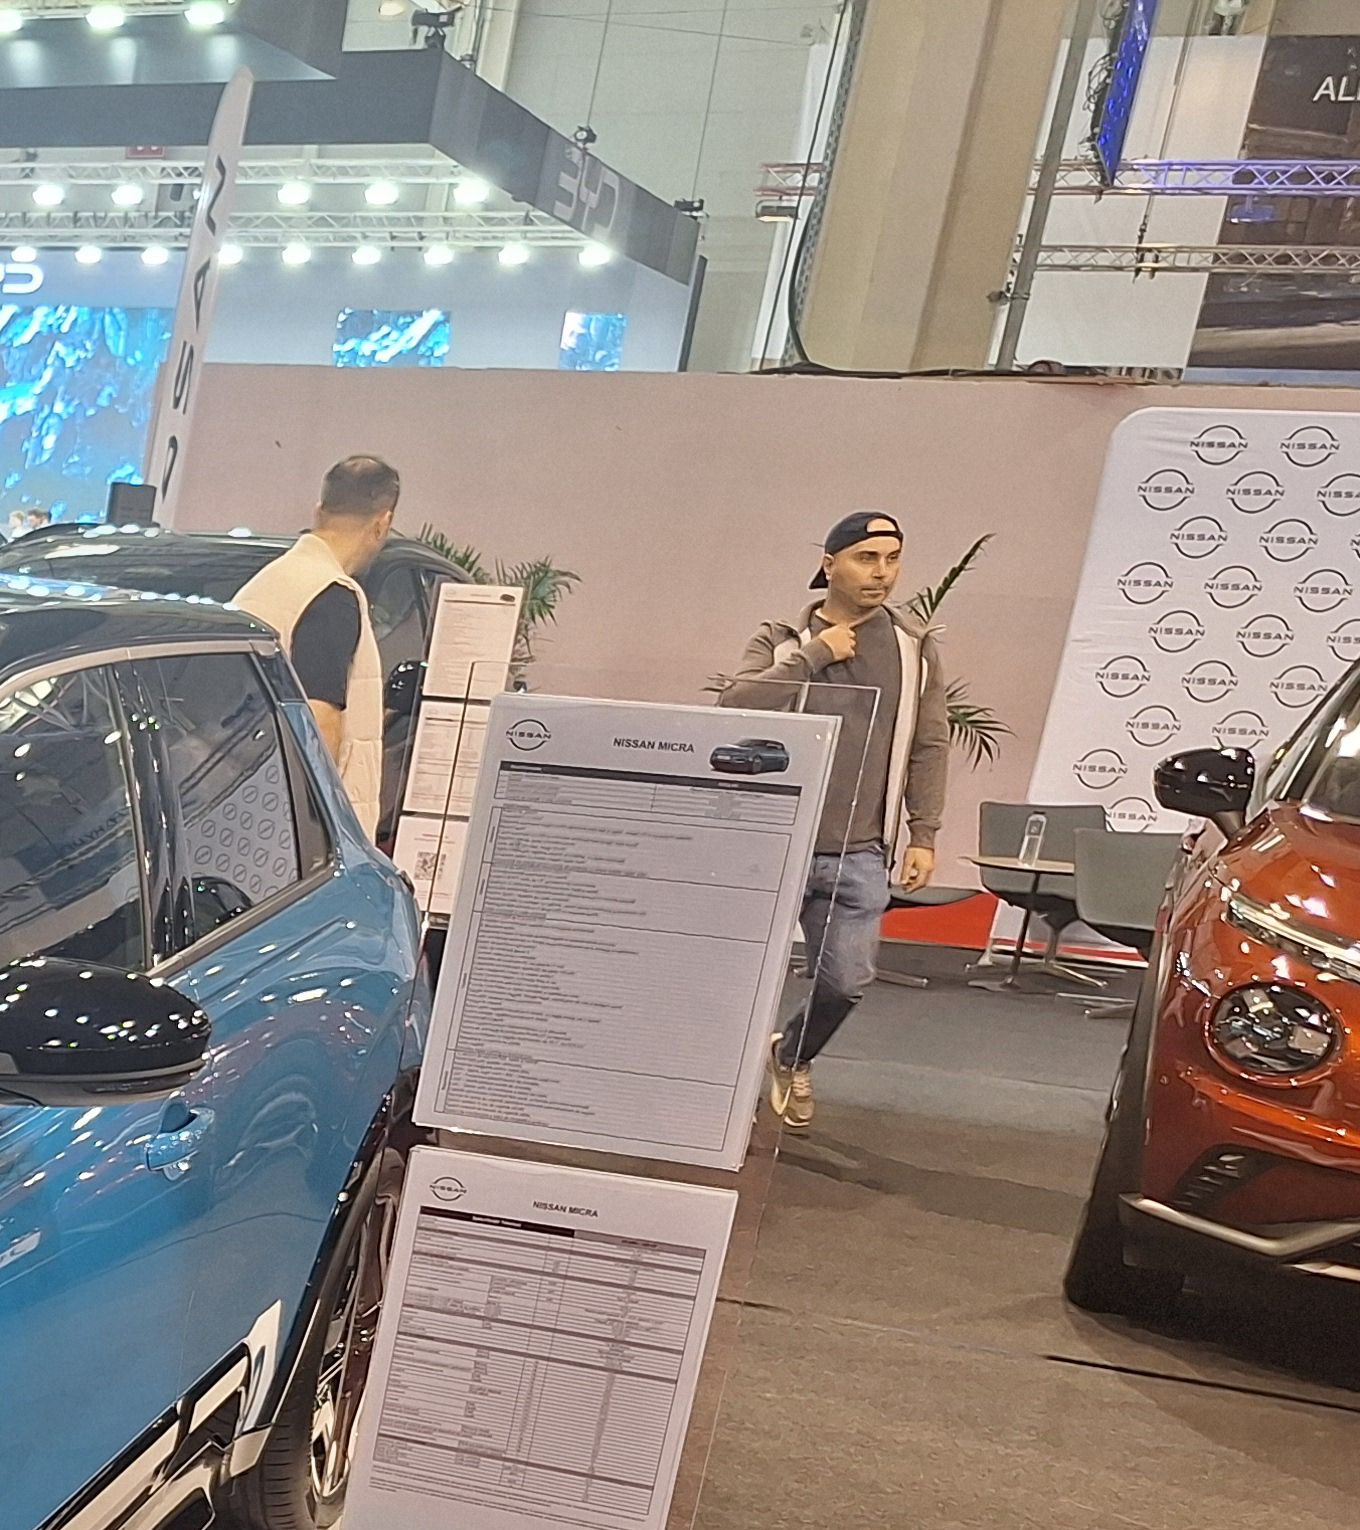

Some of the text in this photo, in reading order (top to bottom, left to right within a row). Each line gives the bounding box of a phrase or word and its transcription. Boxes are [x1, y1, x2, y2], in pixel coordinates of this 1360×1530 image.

[1312, 76, 1360, 102] AL
[1190, 440, 1248, 449] NISSAN
[1280, 441, 1340, 451] NISSAN
[1137, 485, 1195, 495] NISSAN
[1226, 487, 1285, 498] NISSAN
[1317, 489, 1360, 500] NISSA
[1170, 532, 1228, 543] NISSAN
[1259, 534, 1318, 546] NISSAN
[1117, 578, 1174, 589] NISSAN
[1204, 581, 1262, 593] NISSAN
[1294, 585, 1353, 596] NISSAN
[1148, 626, 1205, 637] NISSAN
[1236, 630, 1294, 642] NISSAN
[1095, 671, 1151, 683] NISSAN
[1181, 676, 1238, 688] NISSAN
[1269, 681, 1328, 693] NISSAN
[1125, 720, 1181, 733] NISSAN
[1212, 725, 1269, 738] NISSAN
[505, 730, 552, 740] NISSAN
[613, 737, 695, 753] NISSAN MICRA
[1072, 762, 1128, 775] NISSAN
[430, 1184, 467, 1194] NISSAN
[532, 1200, 599, 1218] NISSAN MICRA
